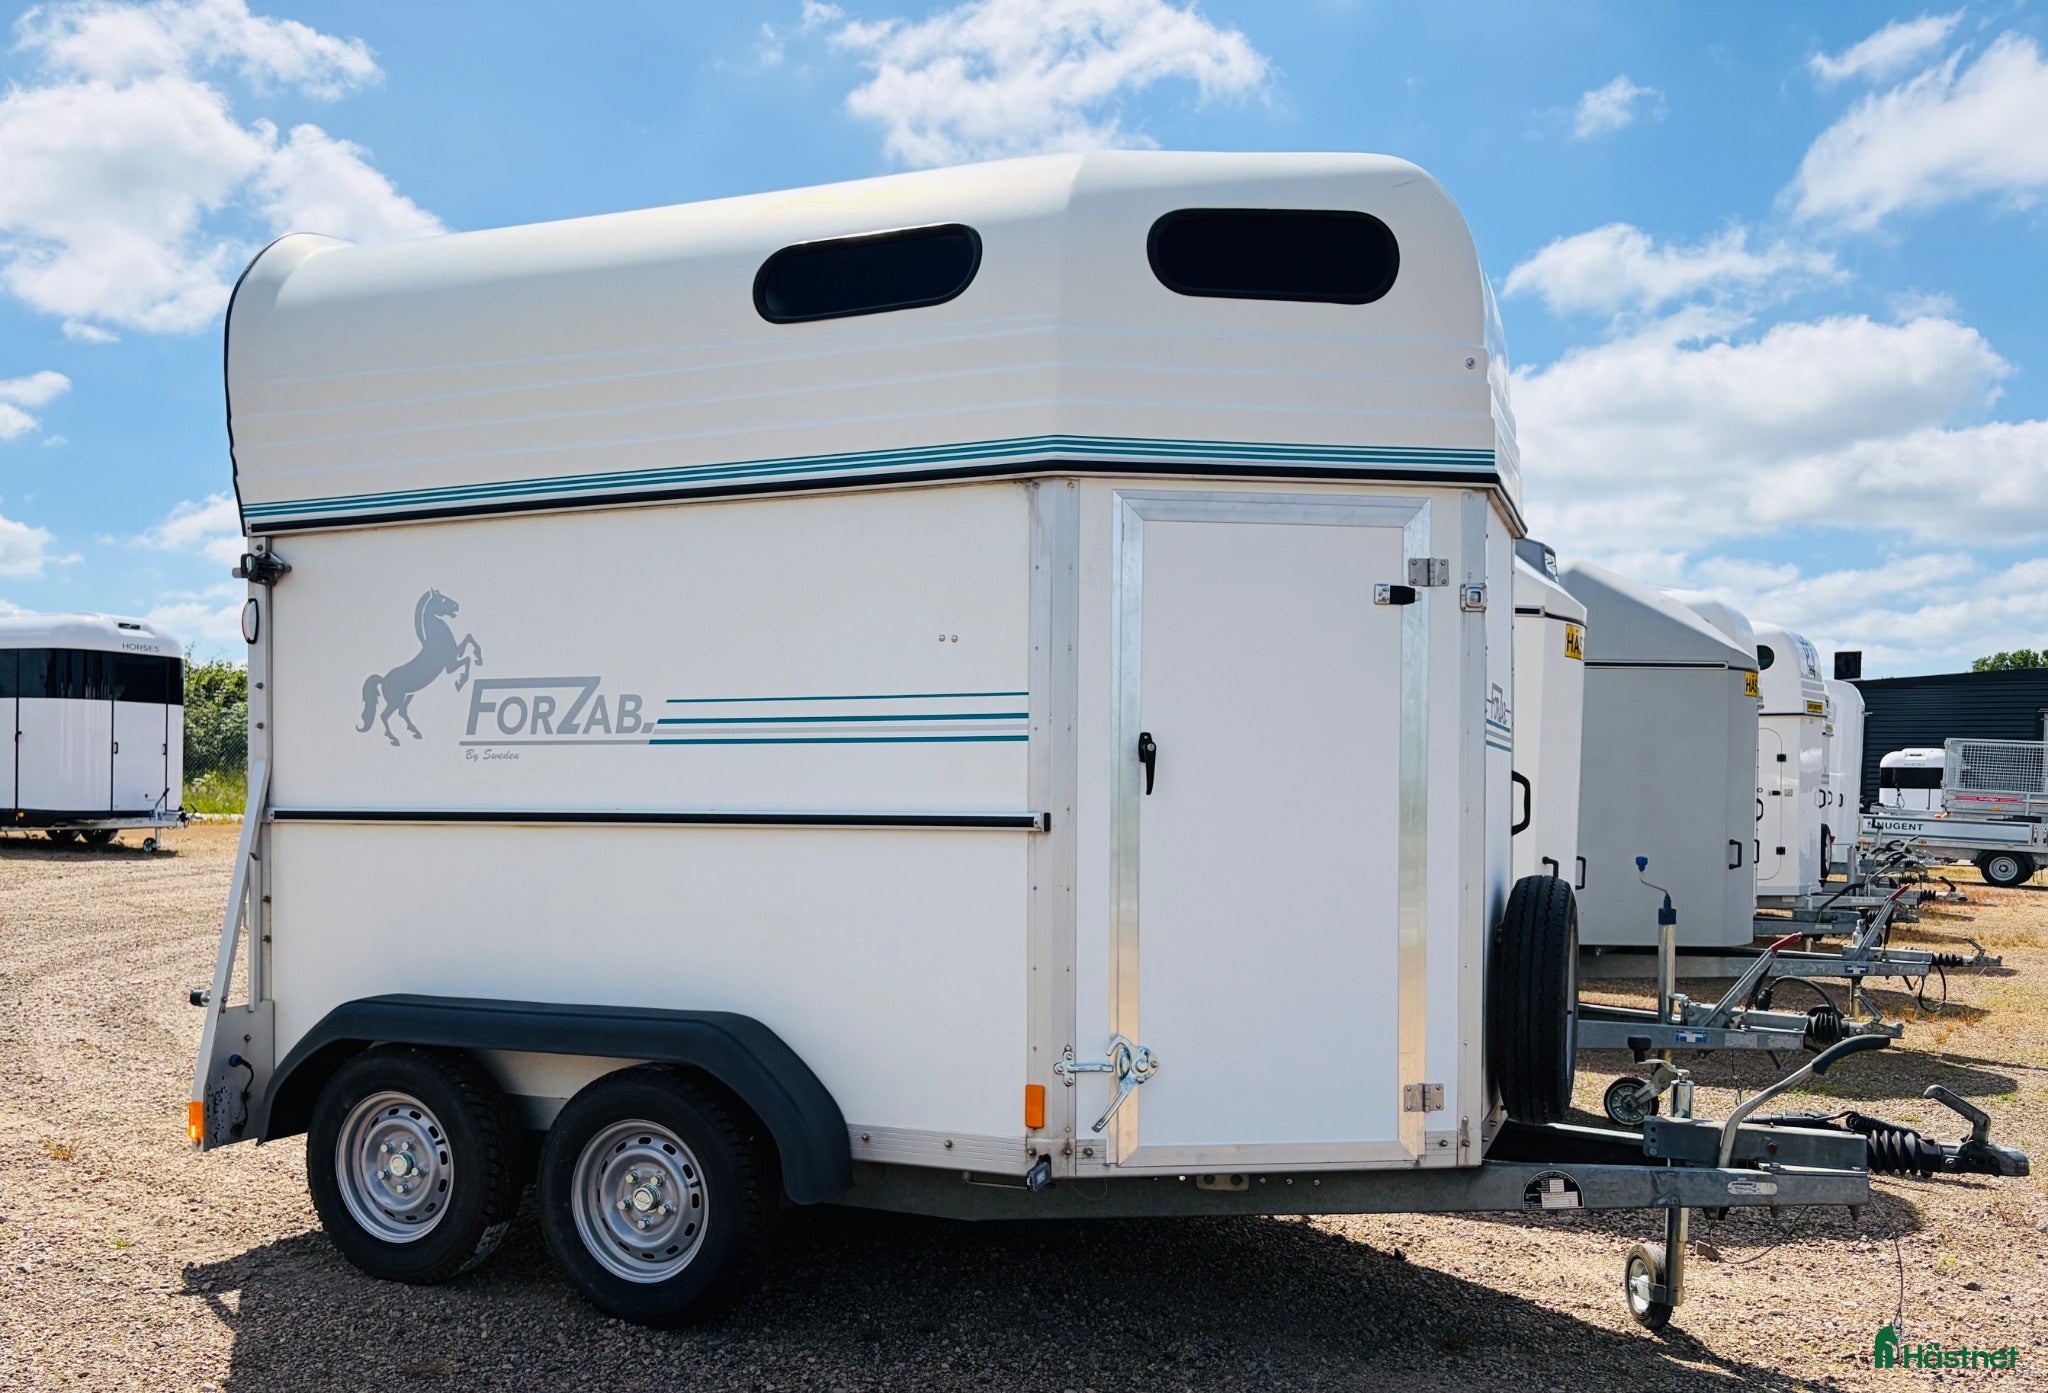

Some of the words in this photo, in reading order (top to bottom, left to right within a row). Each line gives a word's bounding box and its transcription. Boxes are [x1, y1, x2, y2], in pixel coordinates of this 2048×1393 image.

[121, 642, 160, 653] HORSES
[465, 749, 480, 763] By
[482, 749, 520, 761] Sweden
